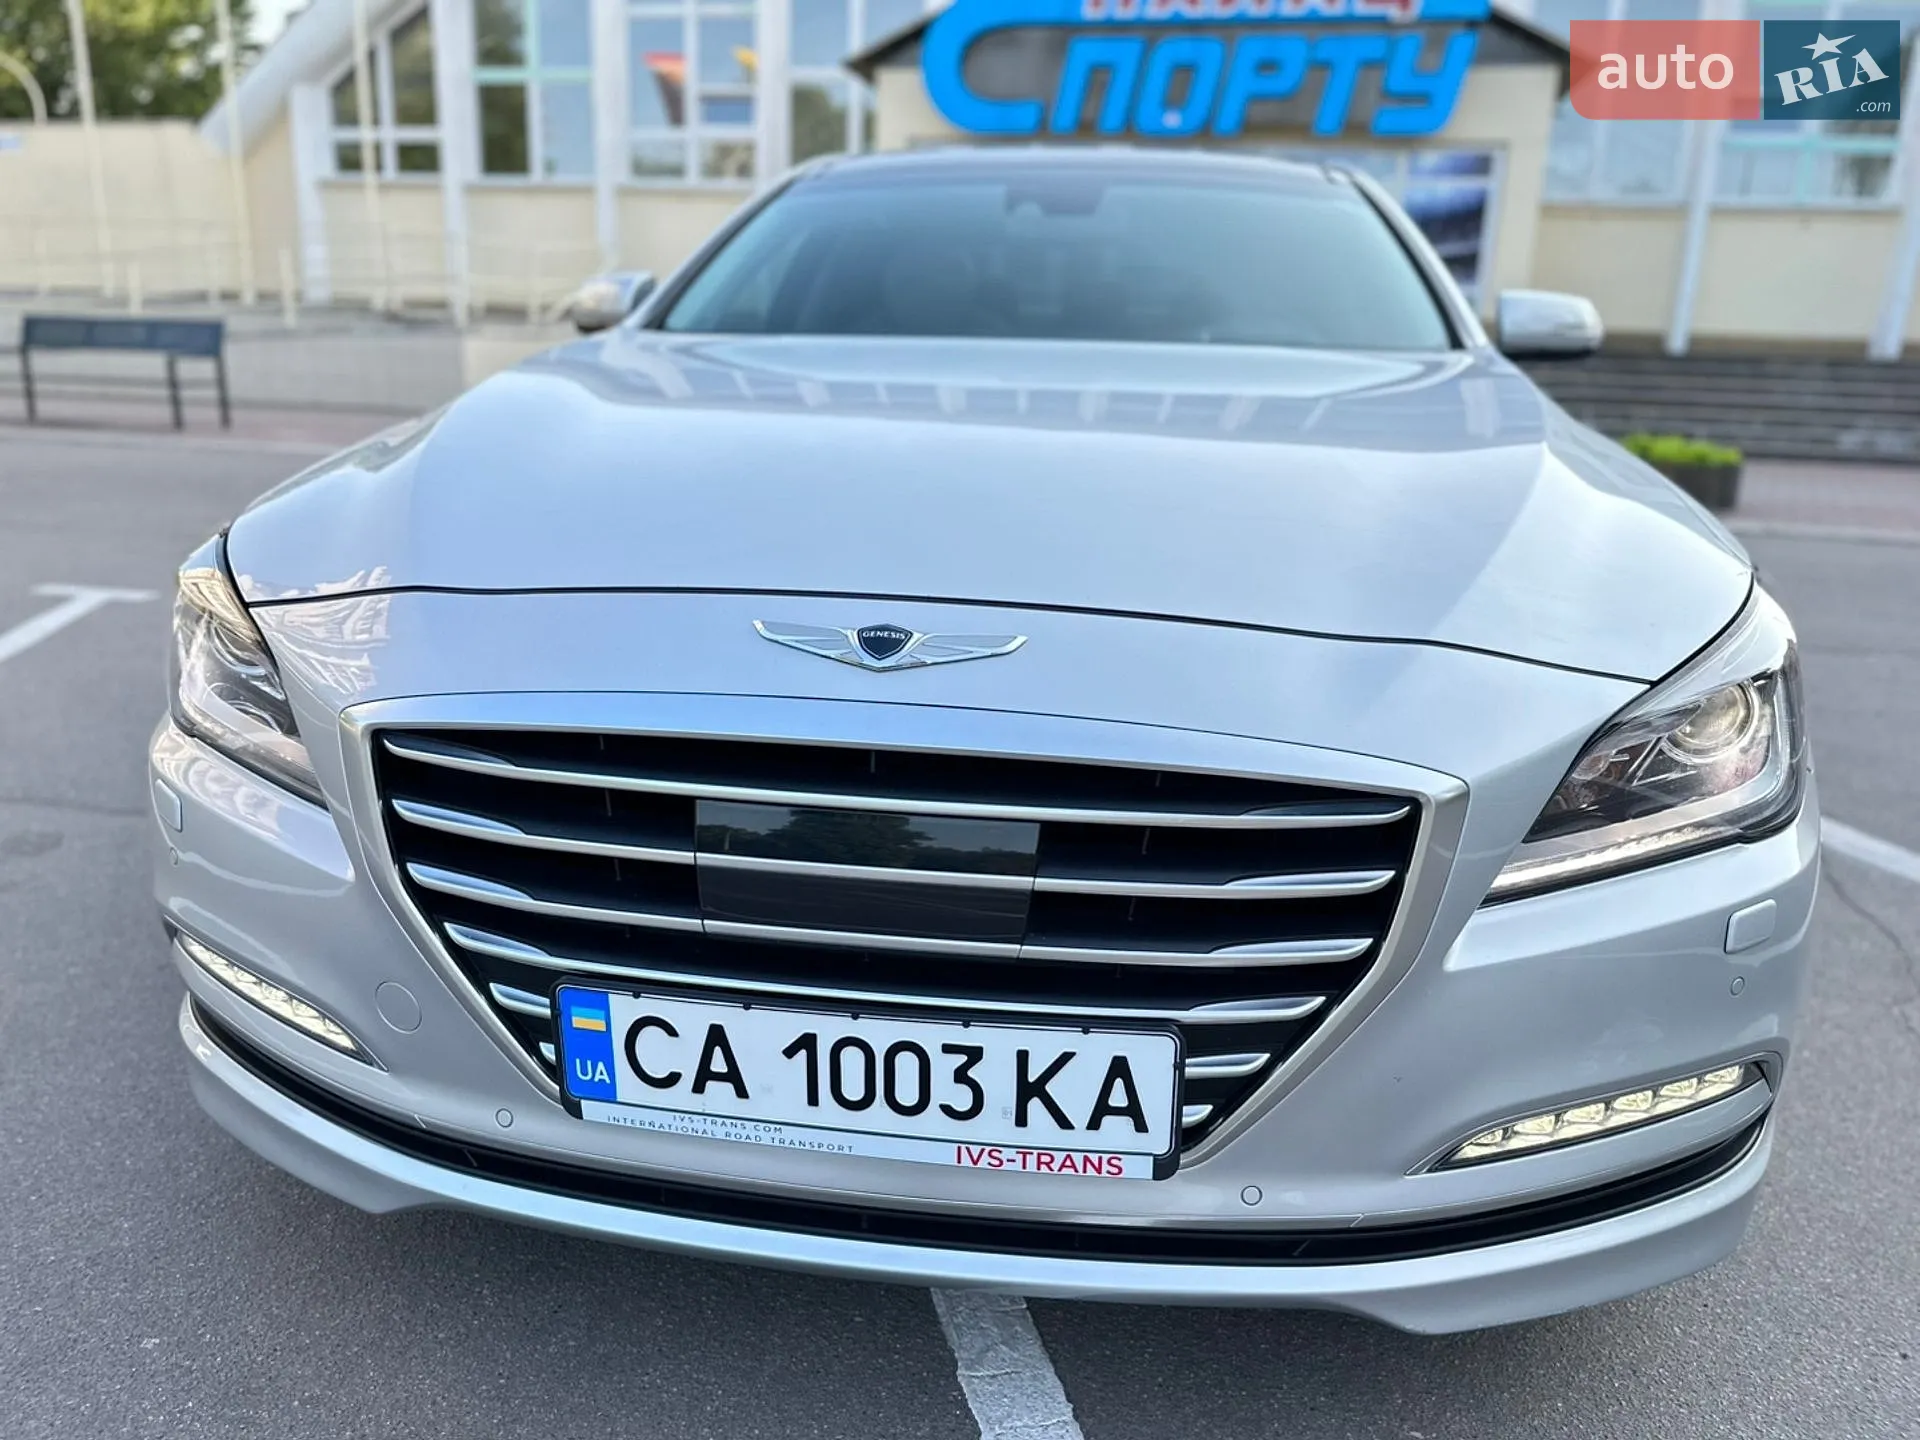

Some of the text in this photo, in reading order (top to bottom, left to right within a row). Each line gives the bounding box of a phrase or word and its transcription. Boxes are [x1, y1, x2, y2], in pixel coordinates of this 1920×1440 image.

[862, 630, 905, 639] GENESIS
[575, 1058, 611, 1084] UA
[624, 1015, 1149, 1133] CA 1003 KA
[606, 1115, 855, 1154] INTERNATIONAL ROAD TRANSPORT
[955, 1144, 1124, 1177] IVS-TRANS
